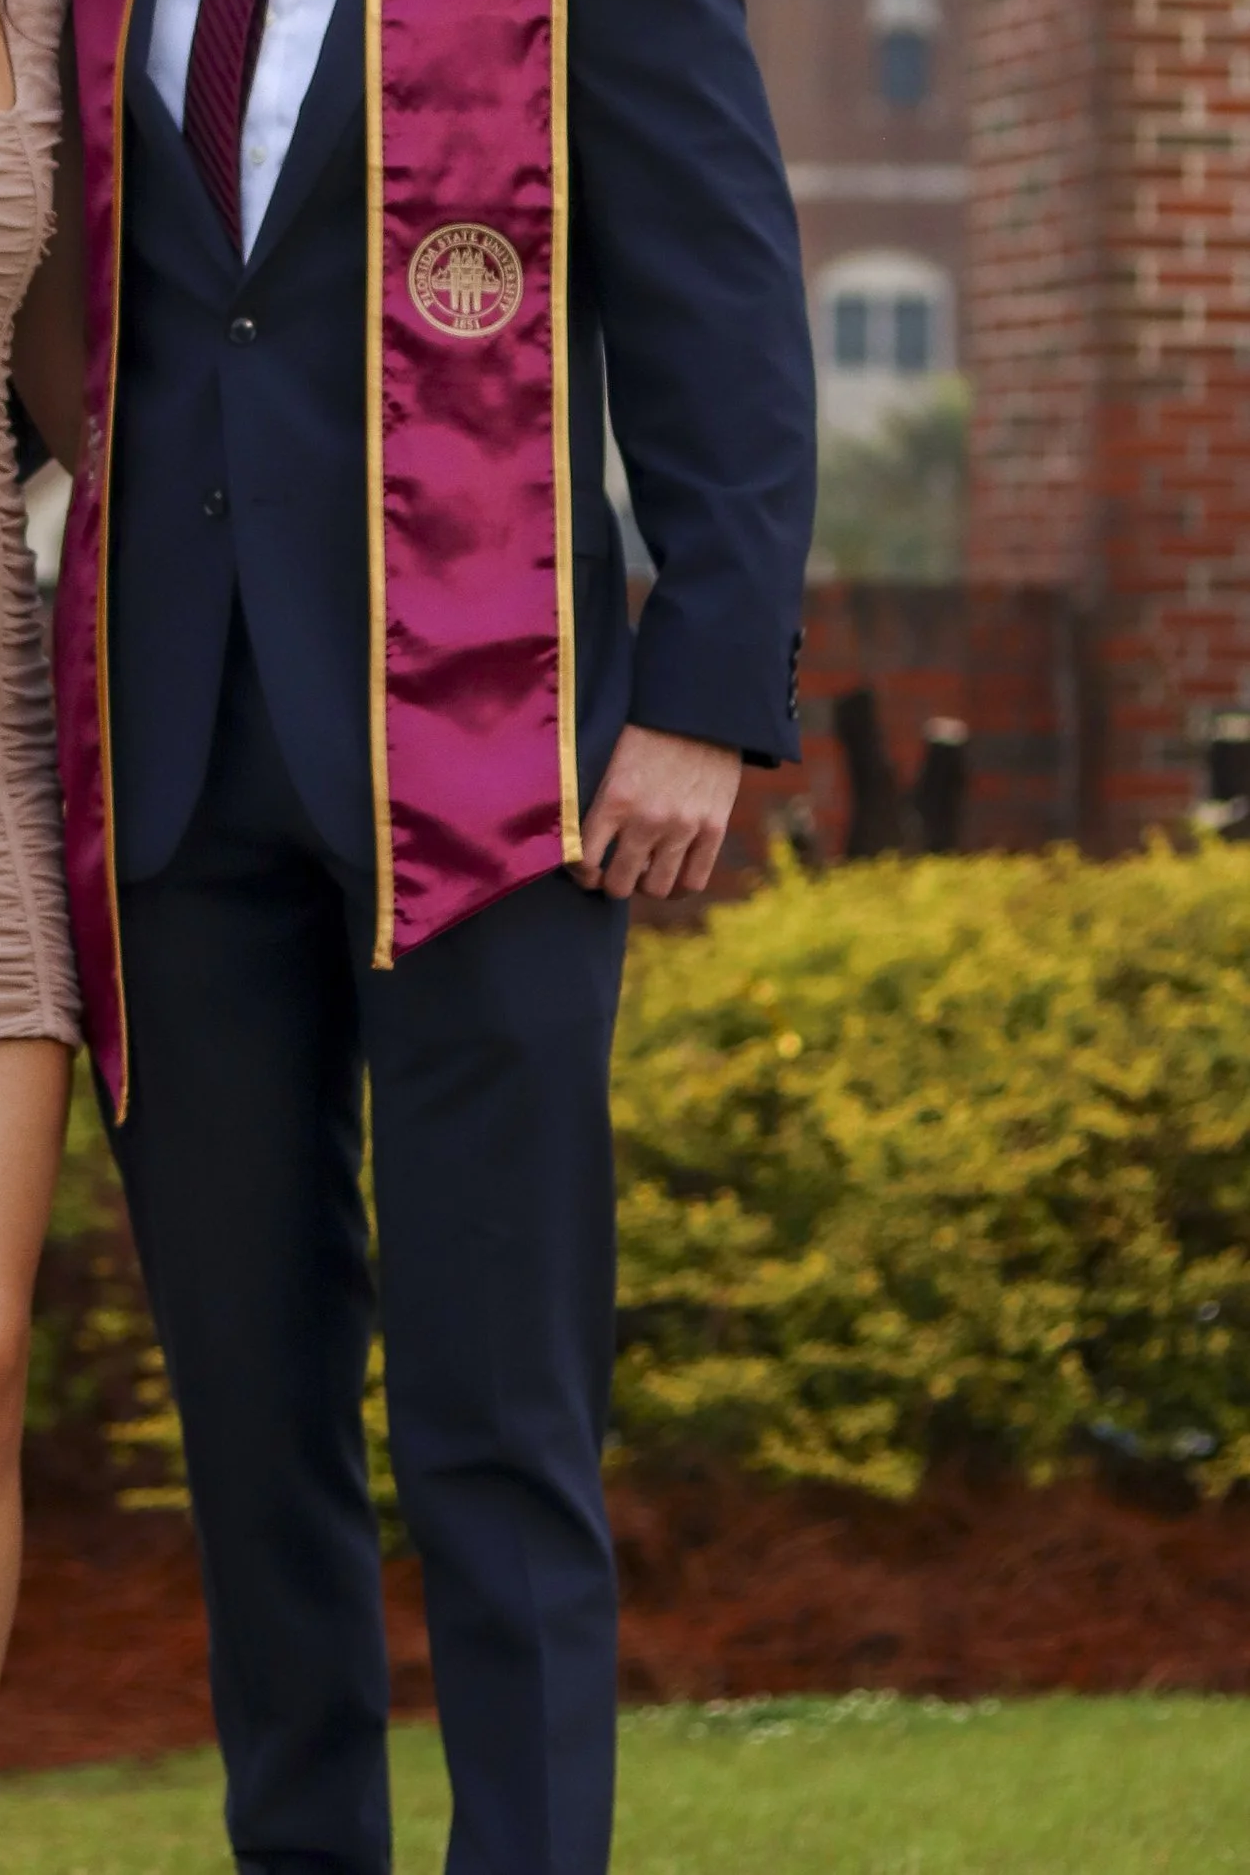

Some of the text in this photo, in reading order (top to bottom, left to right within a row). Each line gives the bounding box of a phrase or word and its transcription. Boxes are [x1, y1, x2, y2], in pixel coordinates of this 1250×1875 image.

[416, 230, 516, 312] FLORIDA STATE UNIVERSITY
